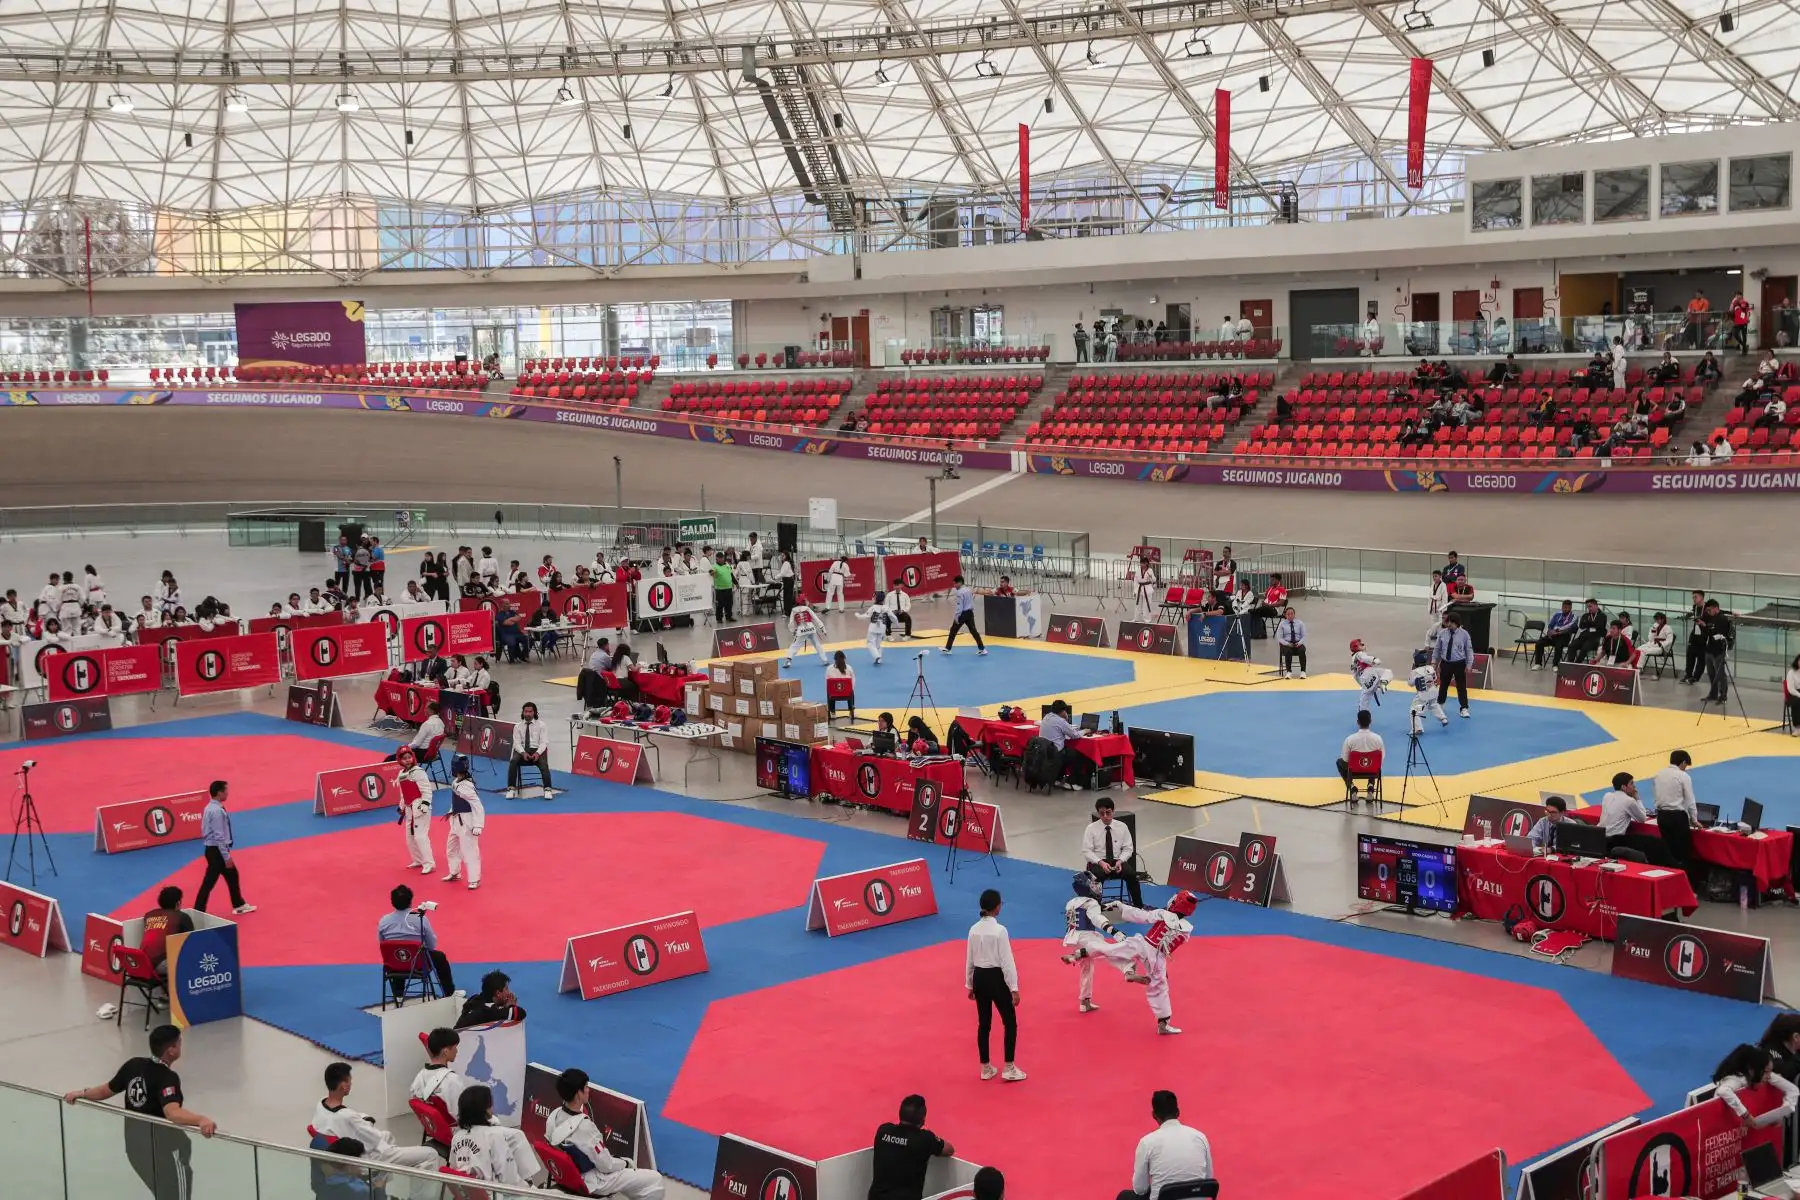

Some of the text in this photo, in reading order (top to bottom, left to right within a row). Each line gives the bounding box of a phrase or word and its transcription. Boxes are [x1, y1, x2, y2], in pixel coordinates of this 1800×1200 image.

[1408, 169, 1420, 185] 104
[207, 392, 322, 404] SEGUIMOS JUGANDO
[556, 411, 657, 432] SEGUIMOS JUGANDO
[868, 446, 962, 464] SEGUIMOS JUGANDO
[1222, 469, 1342, 486] SEGUIMOS JUGANDO
[1652, 473, 1800, 488] SEGUIMOS JUGAN
[682, 524, 714, 536] SALIDA
[320, 704, 324, 718] 1
[767, 760, 772, 773] 0
[792, 765, 798, 778] 0
[919, 814, 928, 831] 2
[1183, 862, 1196, 870] PATU
[1378, 864, 1388, 881] 0
[1243, 873, 1255, 892] 3
[1398, 872, 1416, 882] 1:05
[1425, 870, 1435, 888] 0
[907, 886, 921, 896] PATU
[1476, 879, 1503, 895] PATU
[654, 918, 689, 931] TAEKWONDO
[672, 942, 689, 952] PATU
[1631, 946, 1650, 957] PATU
[592, 980, 629, 993] TAEKWONDO
[535, 1104, 550, 1115] PATU
[882, 1133, 907, 1146] JACOBI
[1705, 1140, 1741, 1166] DEPORTIVA
[1706, 1157, 1736, 1180] PERUANA
[729, 1180, 747, 1194] PATU
[1705, 1180, 1715, 1195] DE
